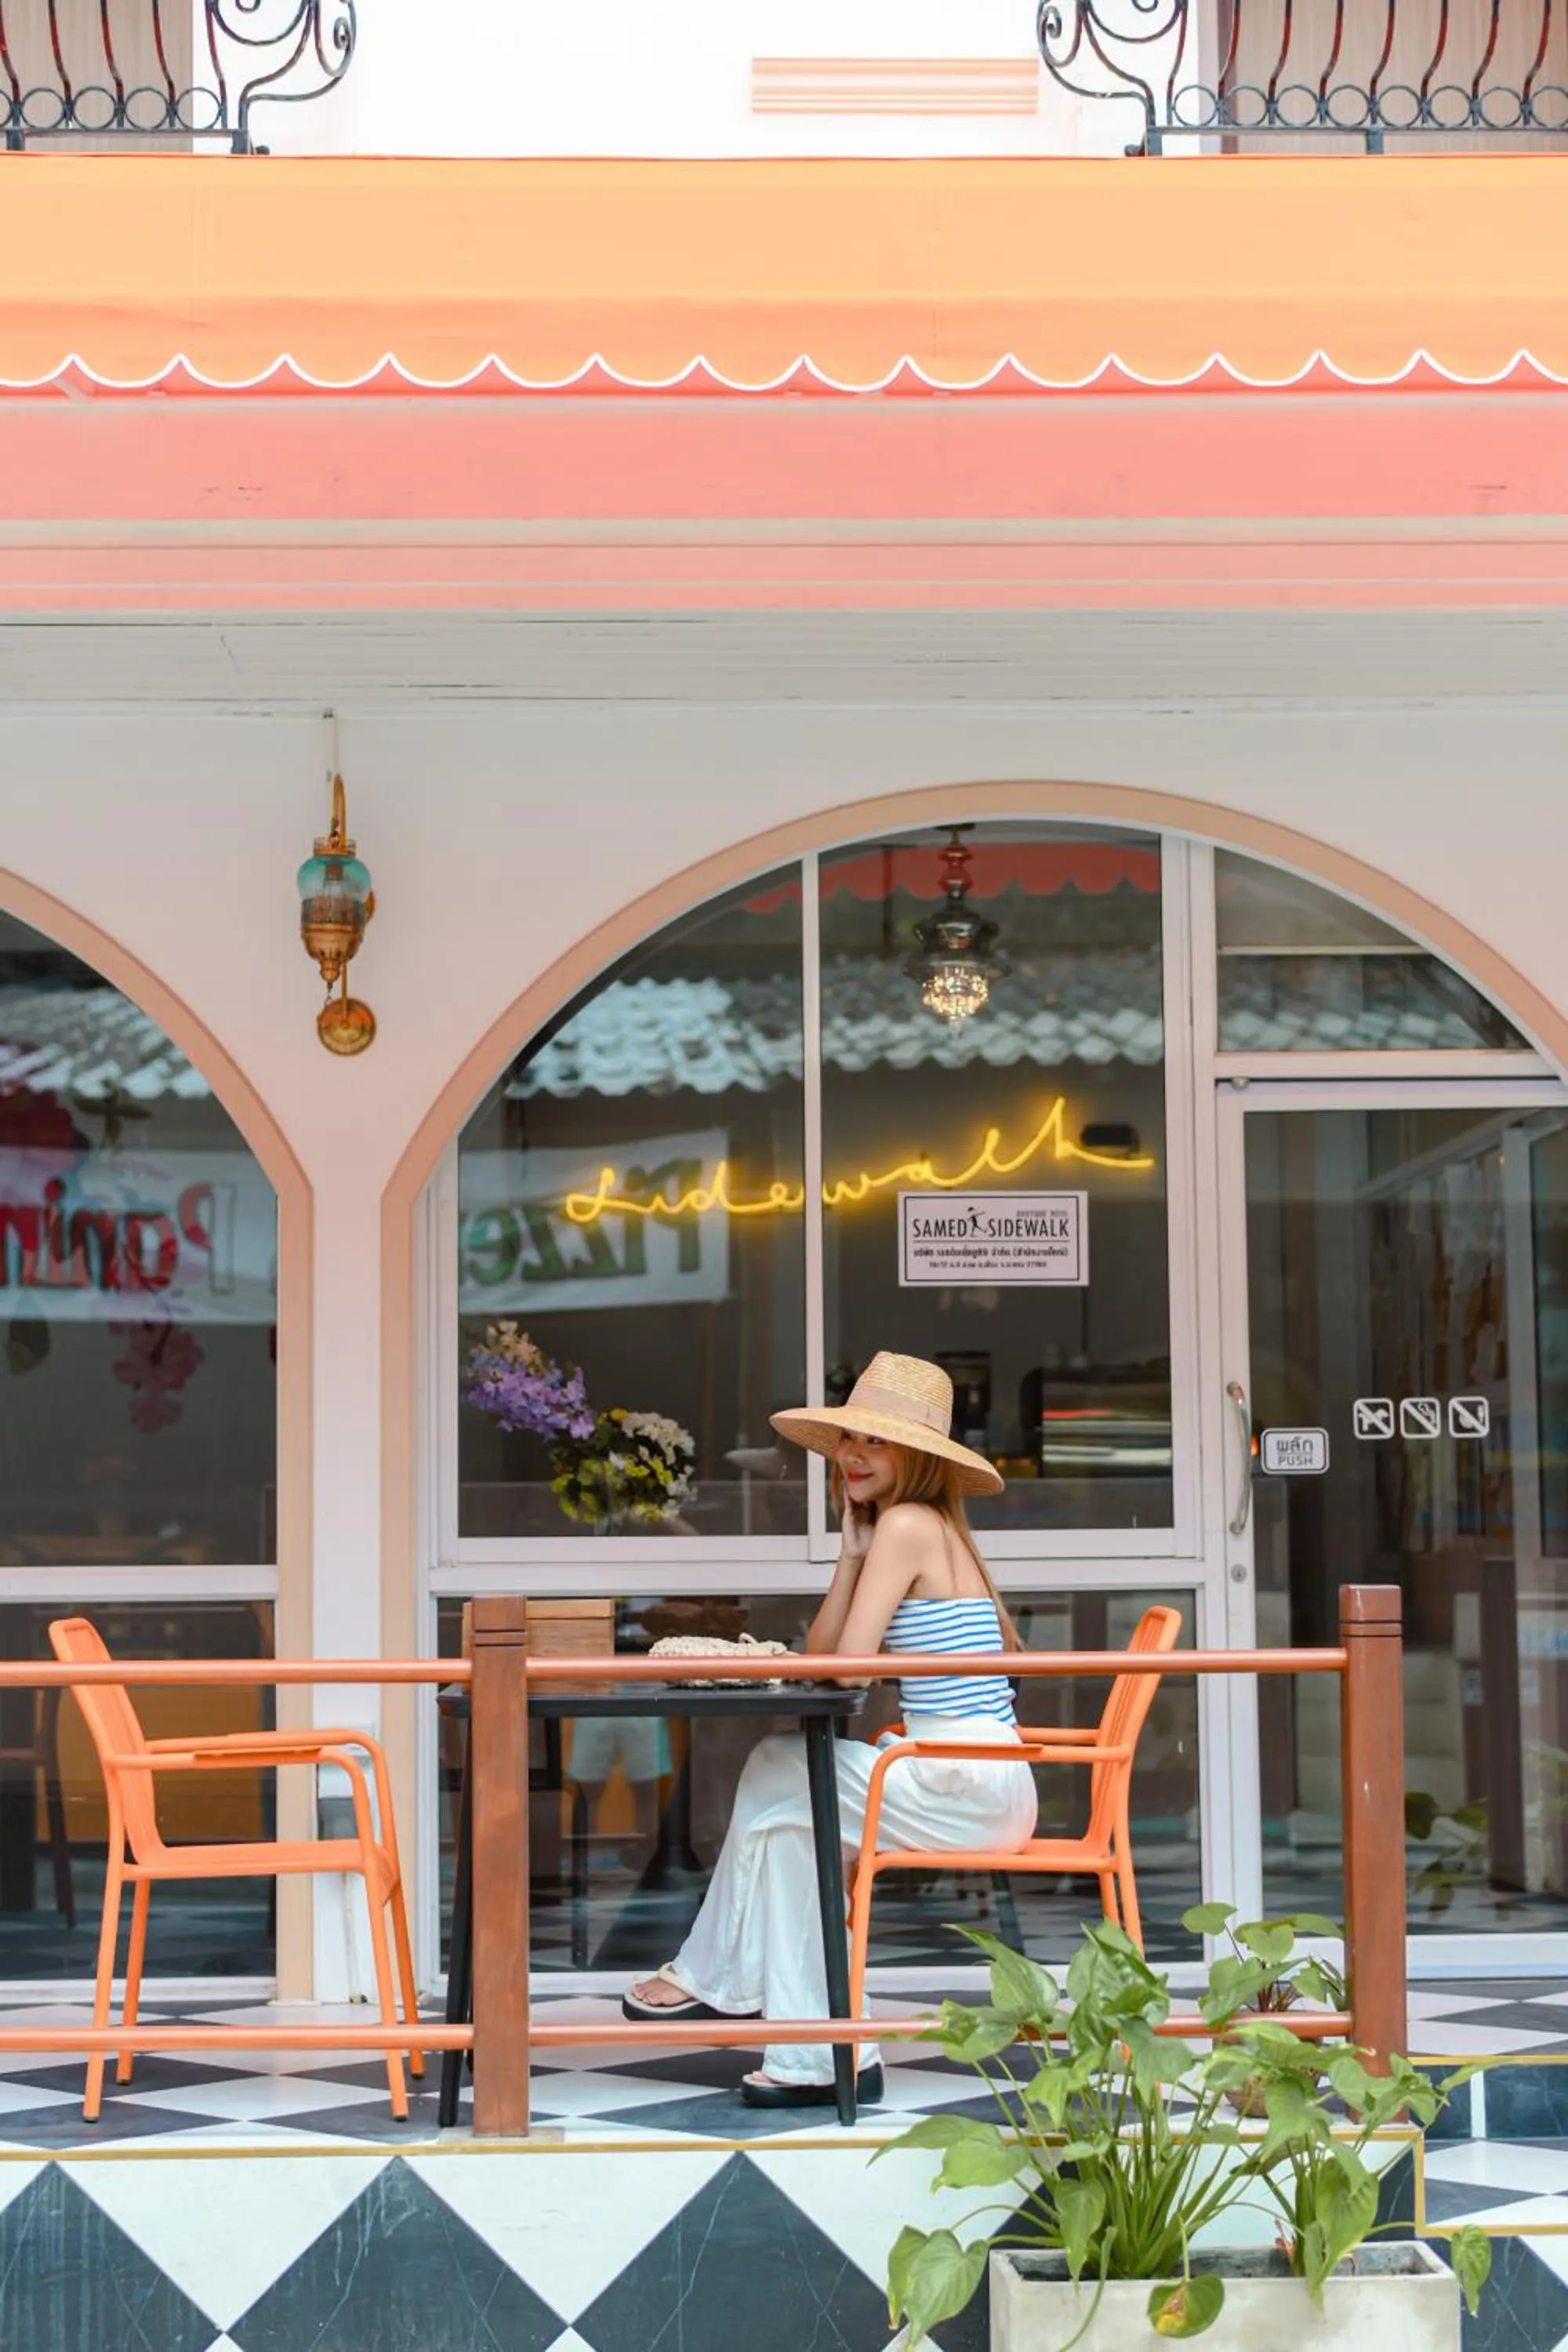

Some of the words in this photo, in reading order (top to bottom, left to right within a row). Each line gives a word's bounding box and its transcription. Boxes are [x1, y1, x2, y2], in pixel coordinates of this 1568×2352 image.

[913, 1218, 967, 1238] SAMED
[988, 1218, 1069, 1238] SIDEWALK
[1278, 1455, 1313, 1466] PUSH
